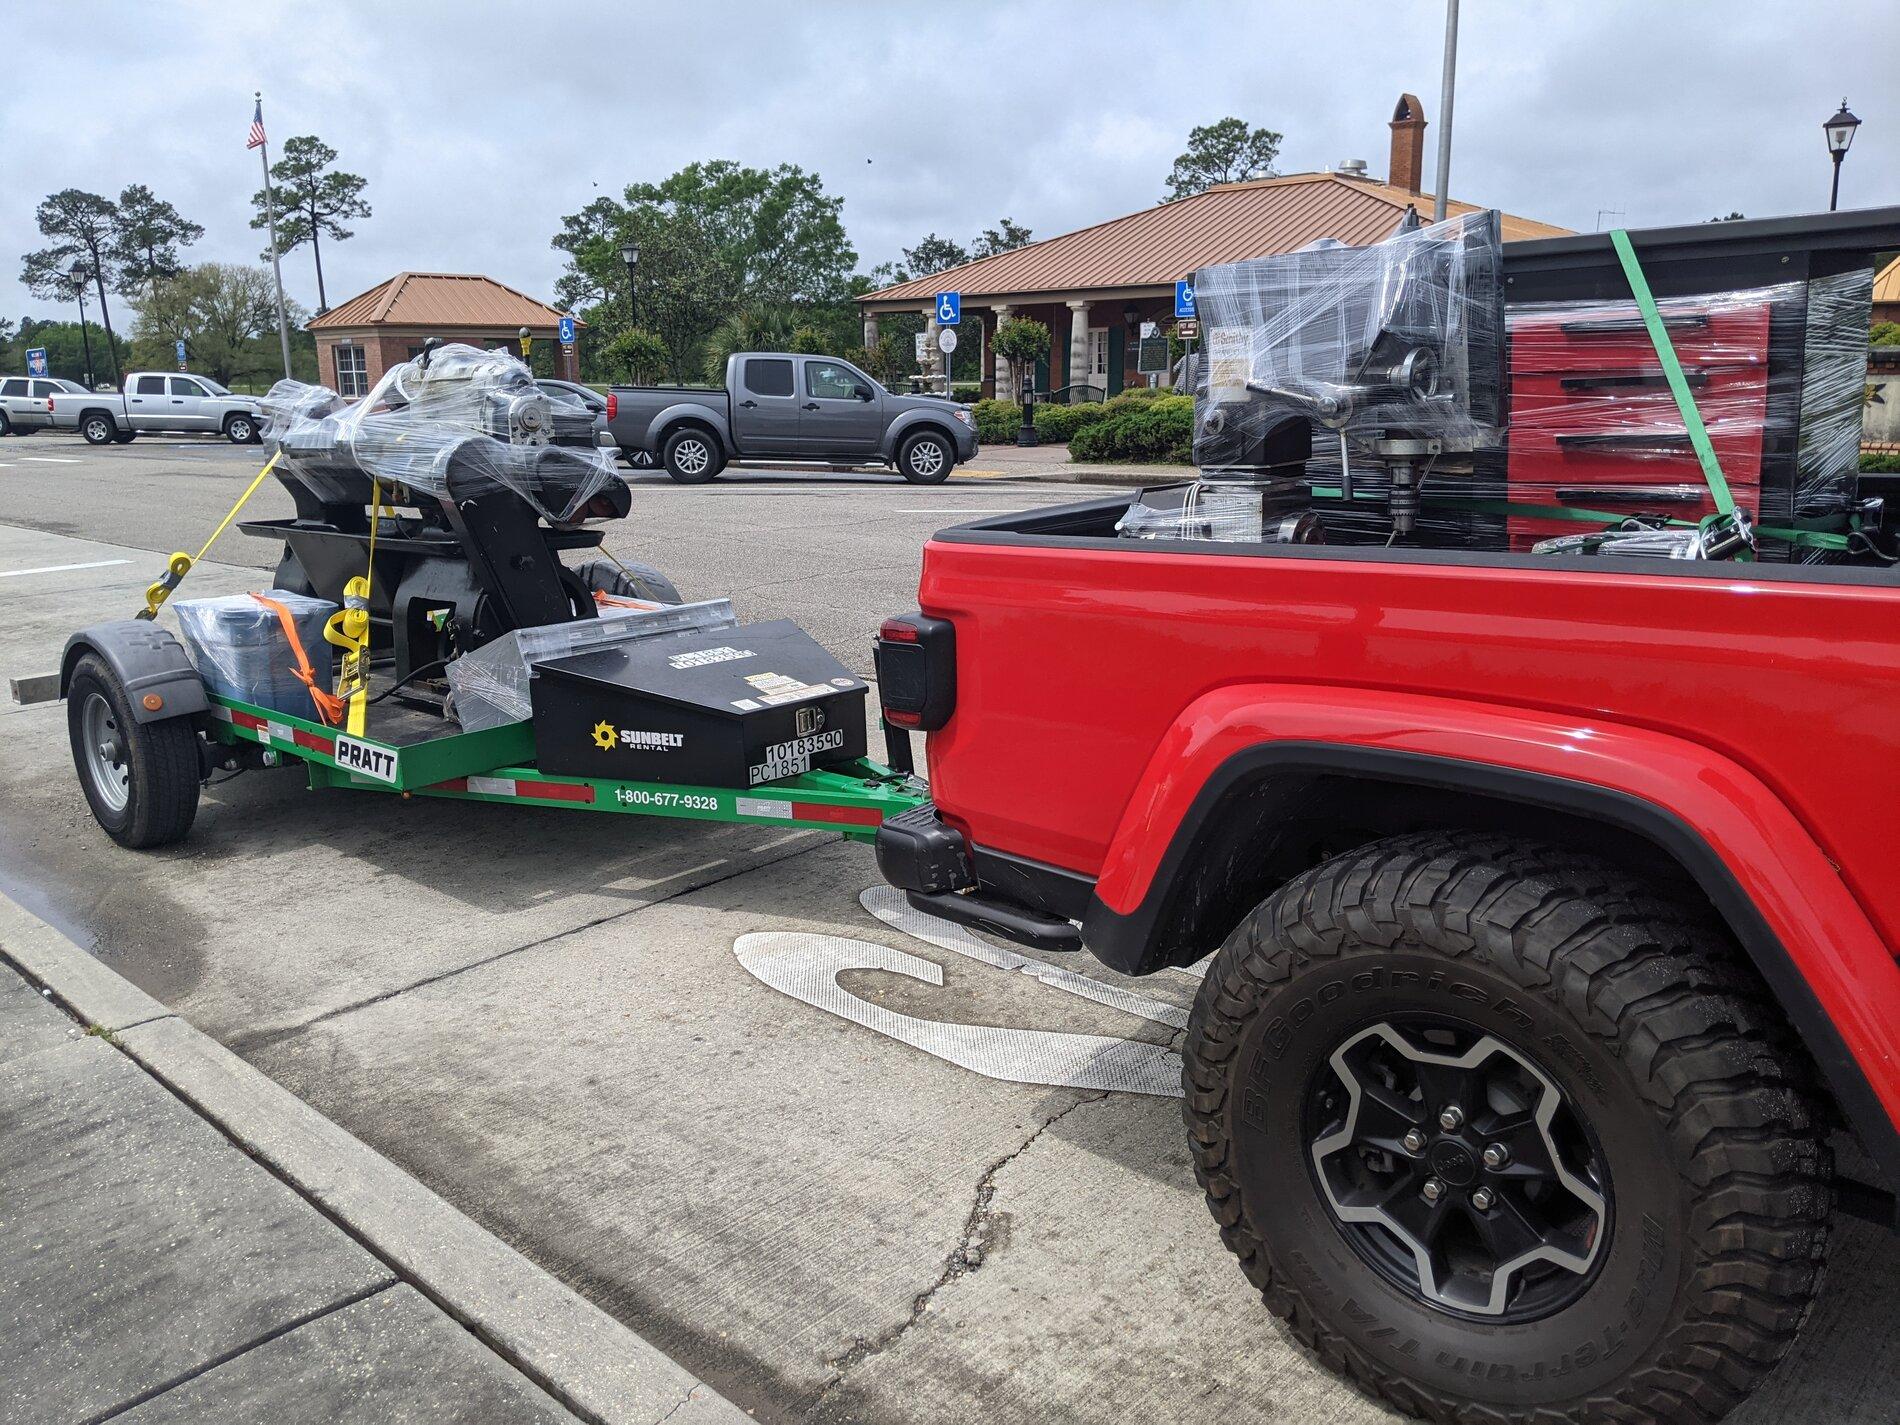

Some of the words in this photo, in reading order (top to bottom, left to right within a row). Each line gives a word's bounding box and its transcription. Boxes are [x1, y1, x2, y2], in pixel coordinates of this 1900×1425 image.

[620, 730, 684, 747] SUNBELT
[630, 743, 669, 752] RENTAL
[768, 730, 842, 763] 10183590
[338, 740, 395, 779] PRATT
[751, 755, 808, 784] PC1851
[614, 788, 718, 811] 1-800-677-9328
[1241, 966, 1535, 1135] BFGoodrich
